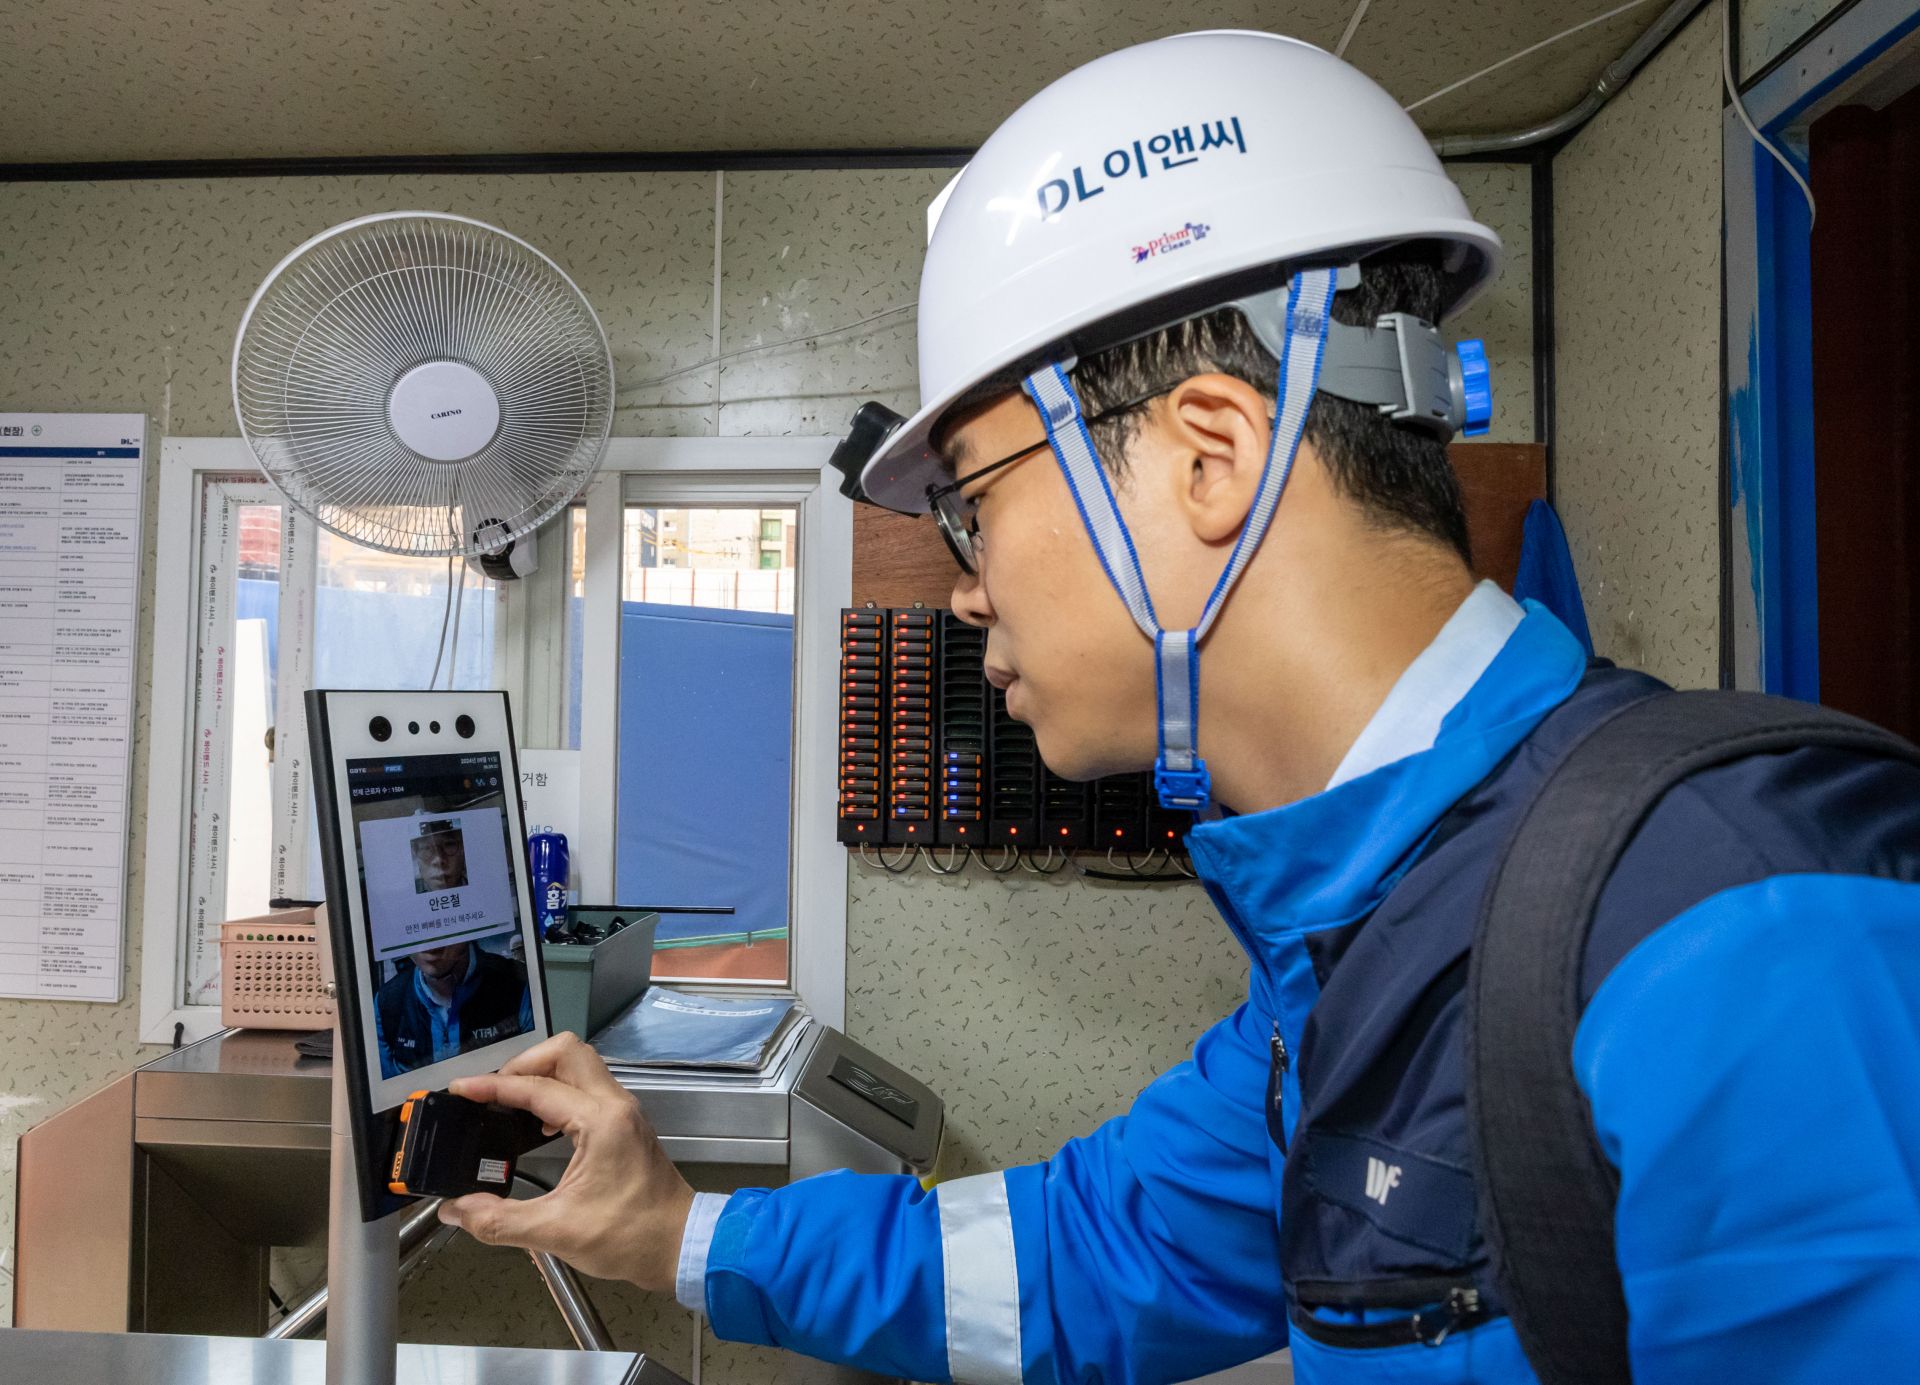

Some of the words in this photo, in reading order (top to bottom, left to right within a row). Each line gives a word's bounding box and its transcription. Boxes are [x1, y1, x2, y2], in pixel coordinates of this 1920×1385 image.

[1037, 116, 1247, 222] DL이앤씨
[1149, 228, 1190, 256] prism
[431, 409, 462, 419] CARINO
[429, 893, 461, 911] 안은철
[405, 924, 420, 935] 안전
[443, 916, 457, 927] 인식
